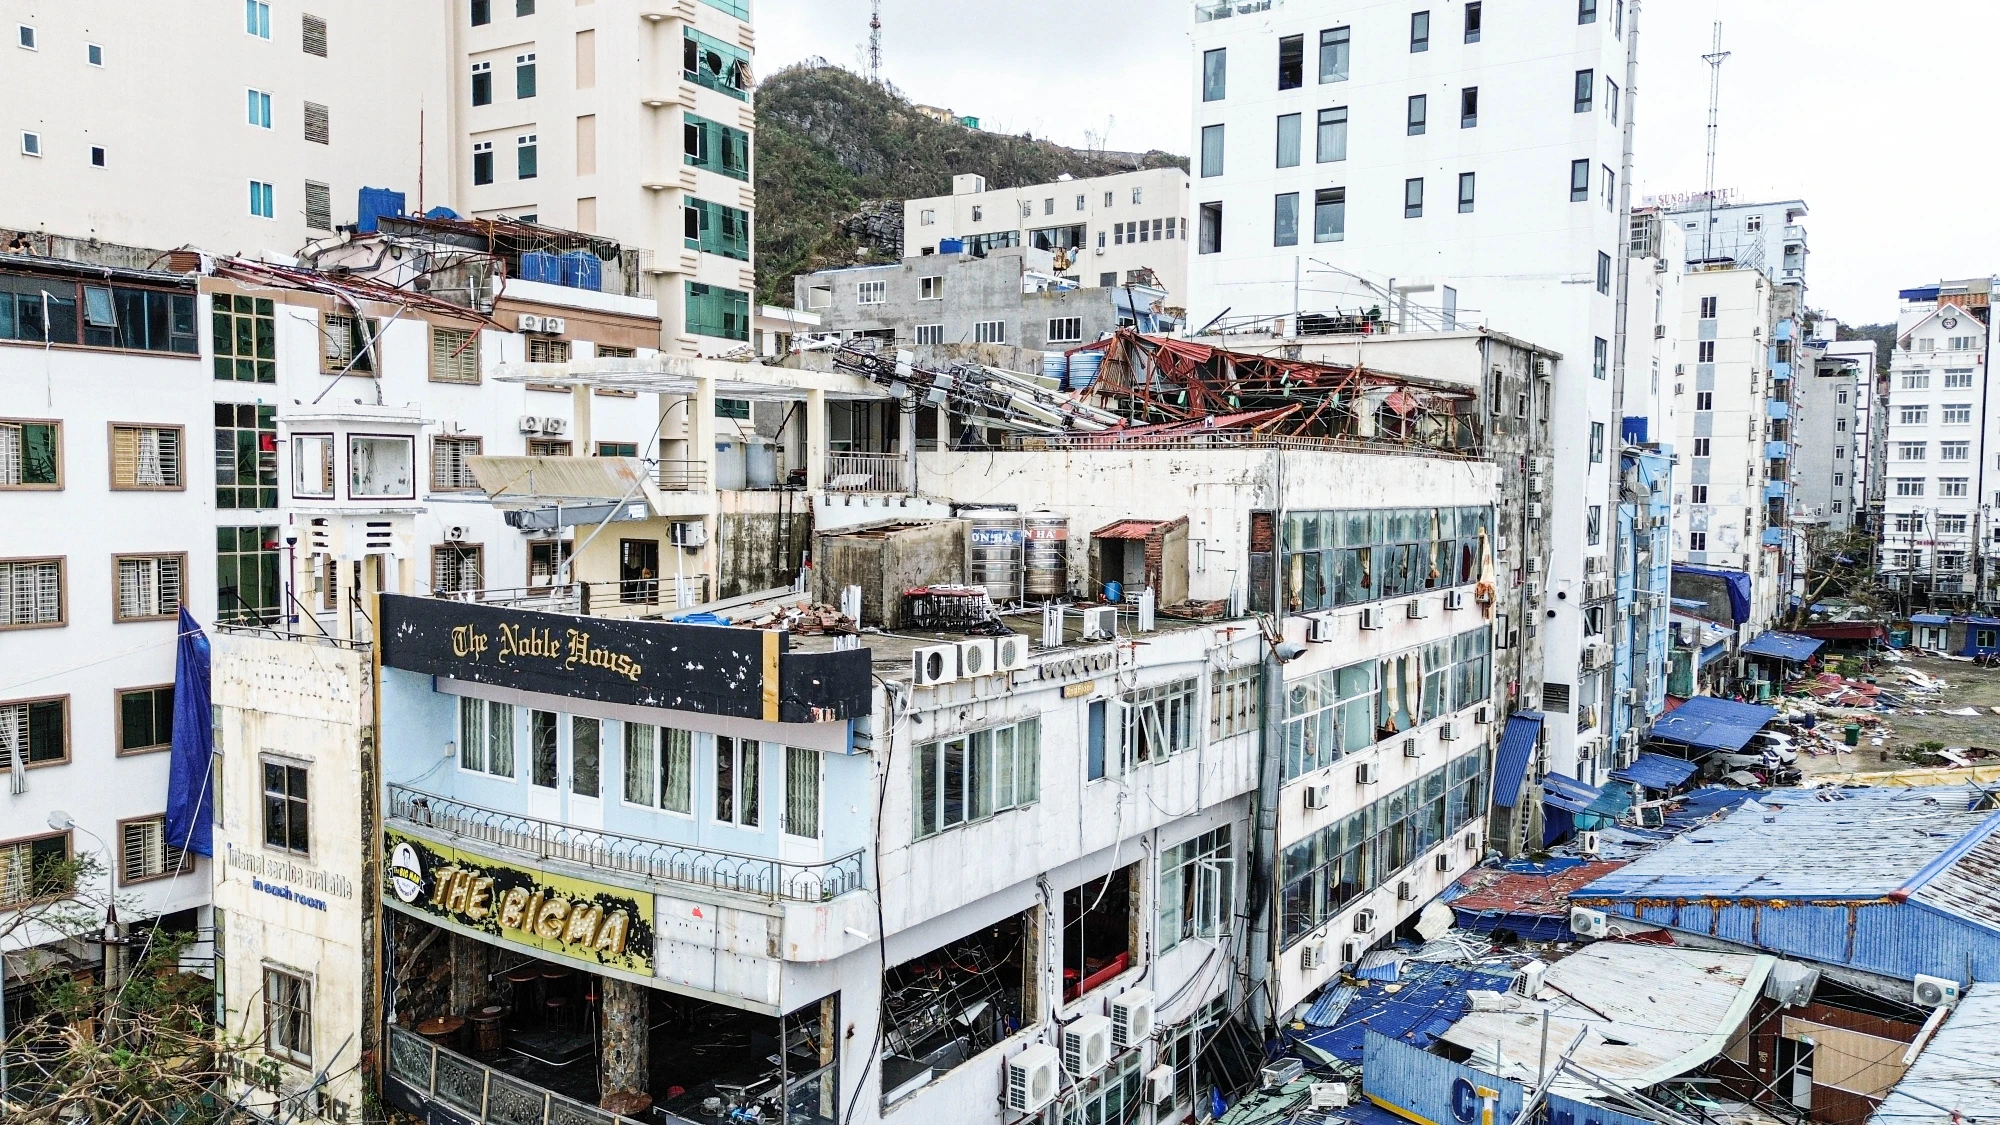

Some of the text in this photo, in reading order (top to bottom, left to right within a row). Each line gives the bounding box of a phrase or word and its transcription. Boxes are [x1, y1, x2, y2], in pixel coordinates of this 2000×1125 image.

[451, 622, 643, 682] The Noble House
[267, 859, 304, 886] service
[305, 870, 353, 900] available
[400, 867, 408, 878] BIG
[252, 876, 327, 912] in each room
[433, 866, 630, 954] THE BIGMA
